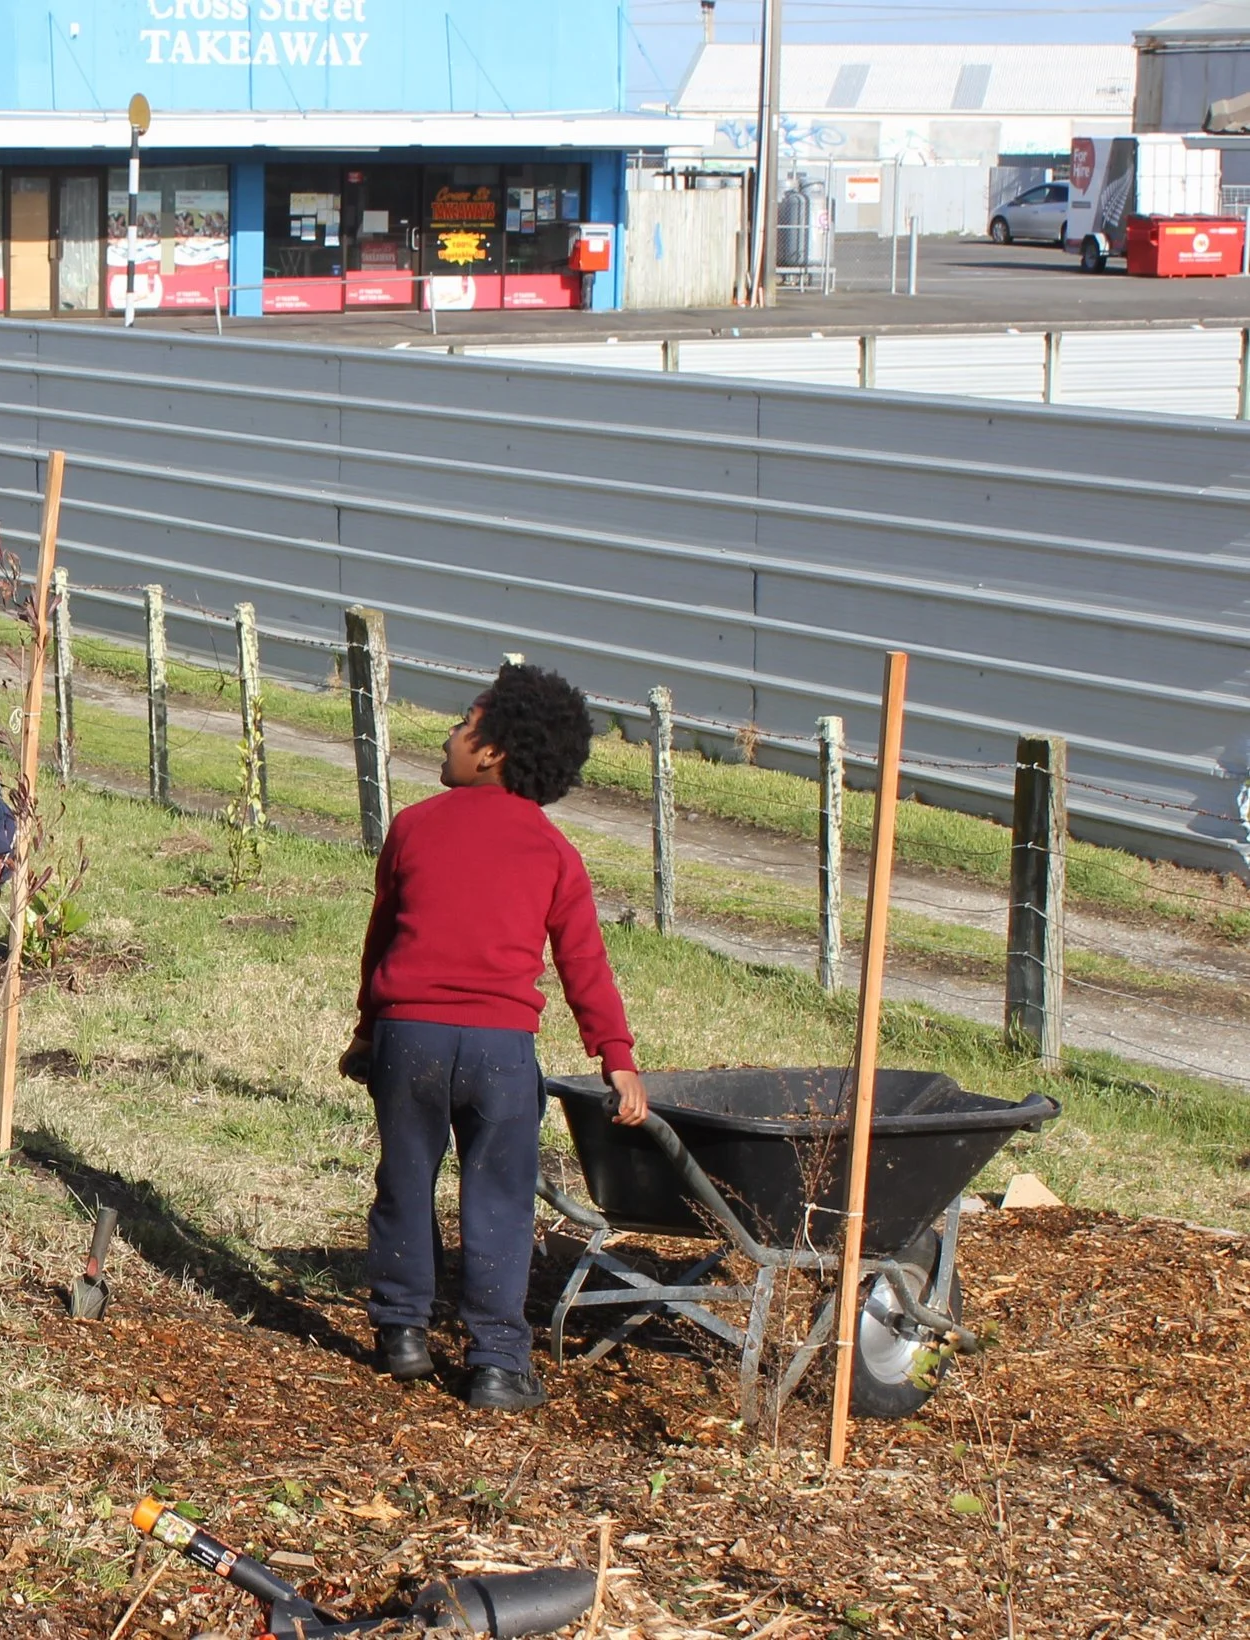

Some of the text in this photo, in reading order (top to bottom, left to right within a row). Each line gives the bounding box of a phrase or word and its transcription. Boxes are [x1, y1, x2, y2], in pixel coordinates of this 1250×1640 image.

[148, 0, 366, 22] Cross Street
[140, 30, 369, 66] TAKEAWAY
[1074, 148, 1088, 162] For
[1073, 163, 1090, 177] Hire
[431, 202, 495, 219] TAKEAWAYS
